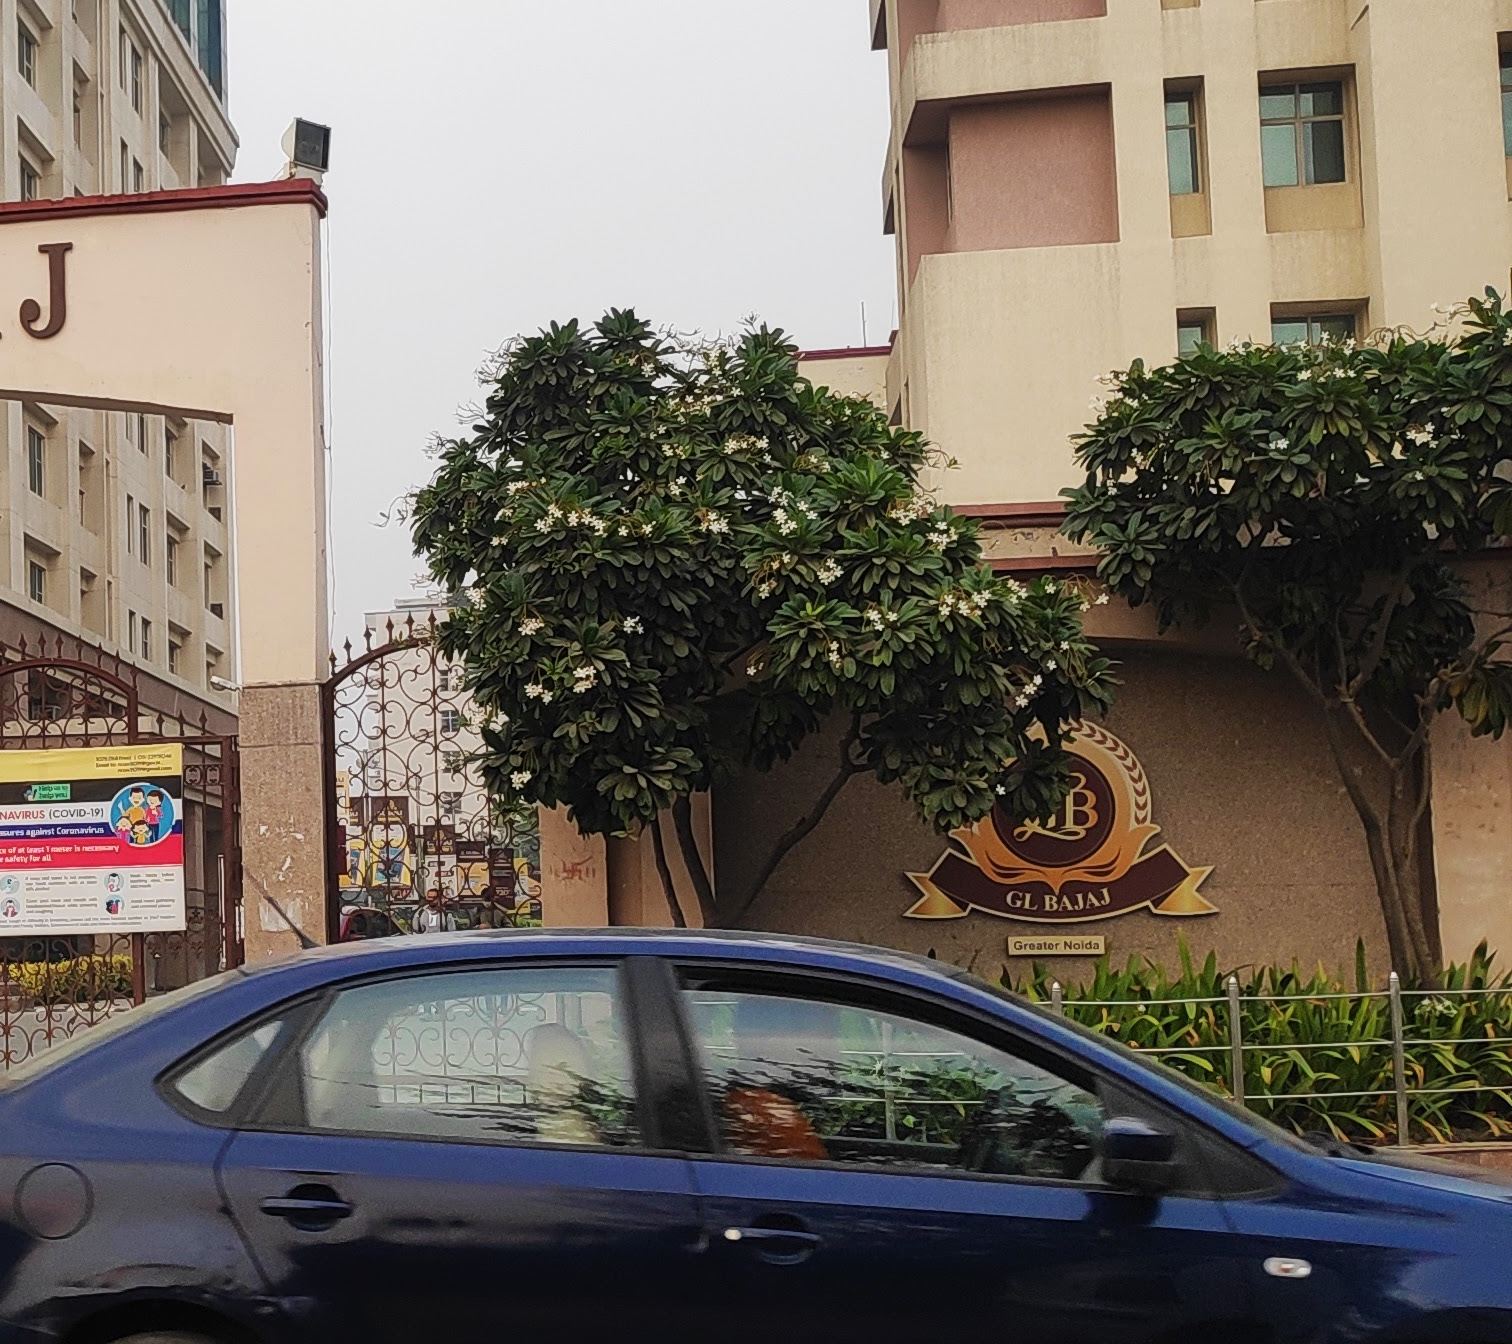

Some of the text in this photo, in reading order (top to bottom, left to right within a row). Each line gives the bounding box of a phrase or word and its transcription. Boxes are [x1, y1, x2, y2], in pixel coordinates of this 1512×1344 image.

[49, 808, 104, 820] (COVID-19)
[26, 827, 55, 838] against
[56, 826, 105, 835] Coronavirus
[1006, 887, 1111, 912] GL BAJAJ
[1013, 940, 1100, 951] Greater Noida
